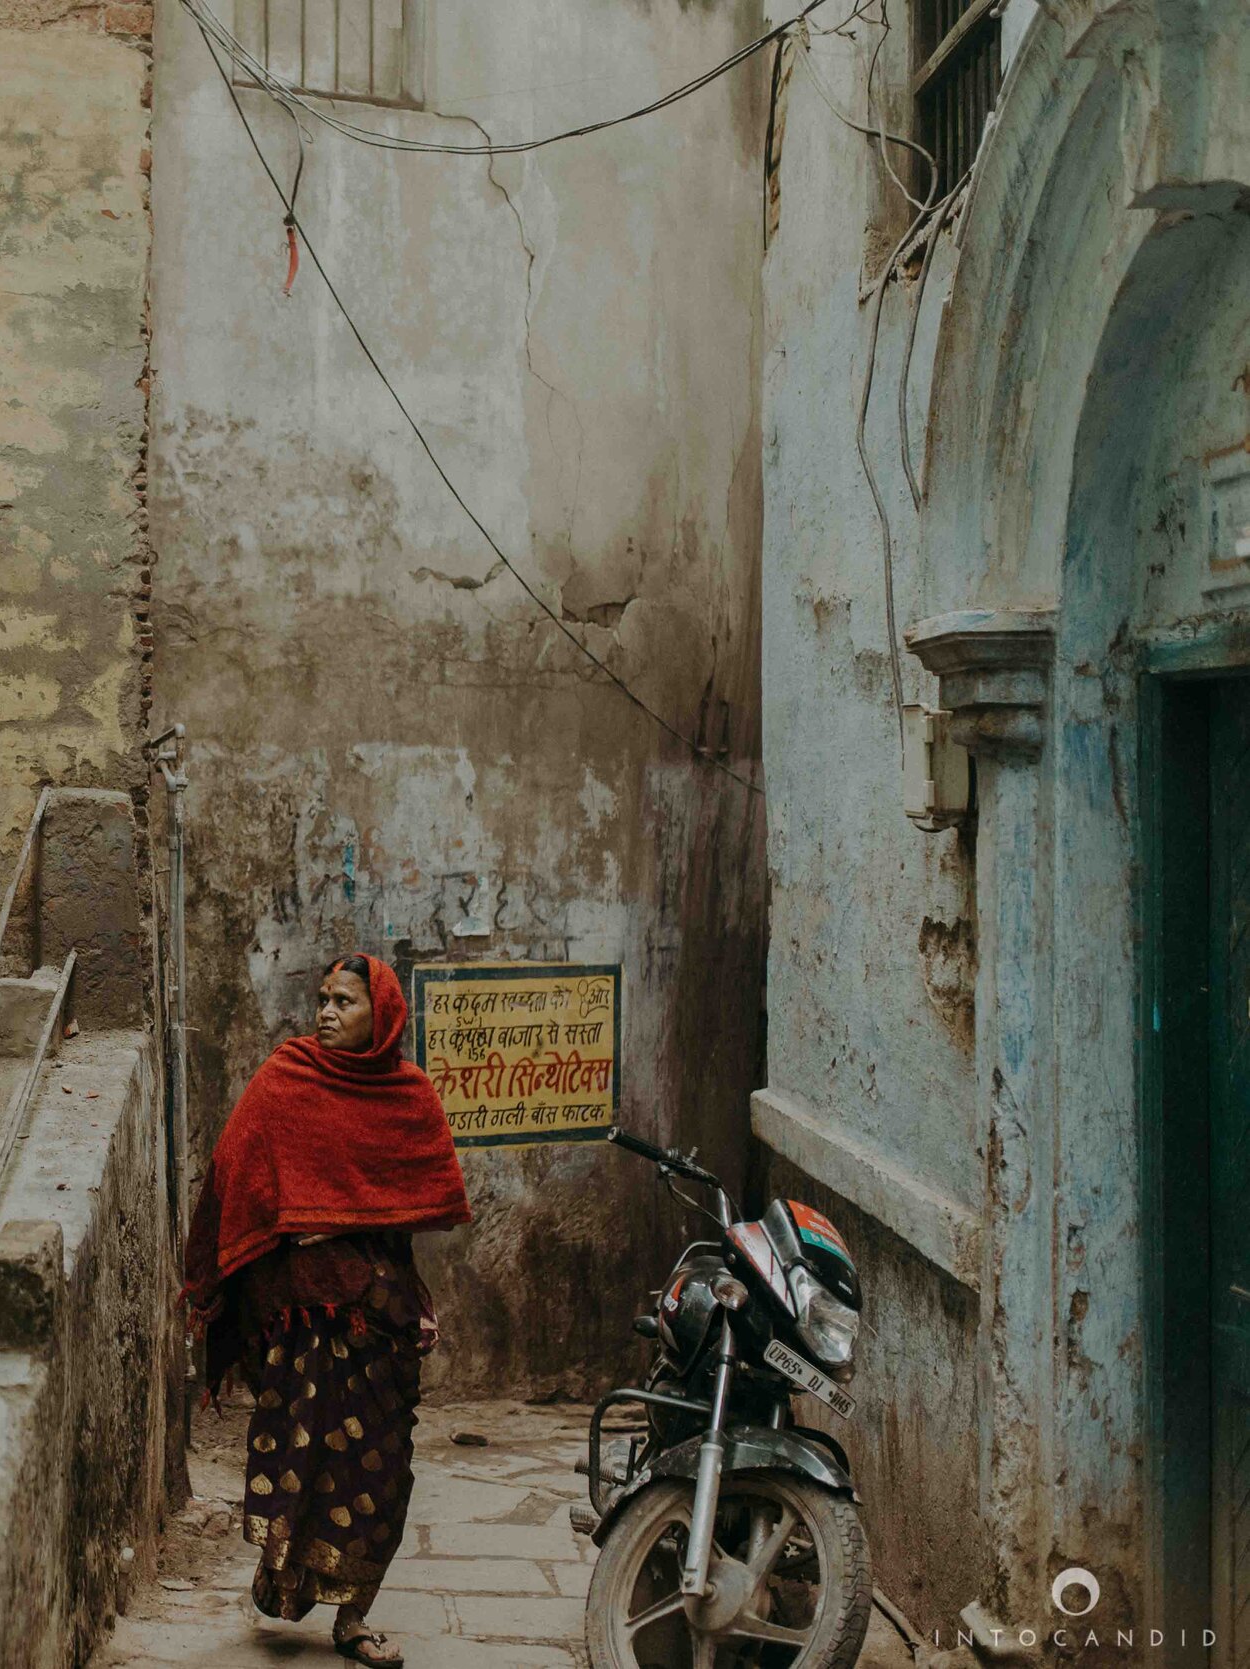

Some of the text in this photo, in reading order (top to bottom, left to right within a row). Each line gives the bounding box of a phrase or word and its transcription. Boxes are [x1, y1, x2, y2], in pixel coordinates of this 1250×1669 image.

[433, 993, 450, 1014] हर
[428, 1029, 447, 1050] हर
[498, 1023, 543, 1048] बाजार
[546, 1019, 559, 1045] से
[564, 1022, 604, 1046] सस्ता
[430, 1051, 507, 1100] केशरी
[447, 1104, 489, 1130] ण्डारी
[562, 1103, 607, 1123] फाटक
